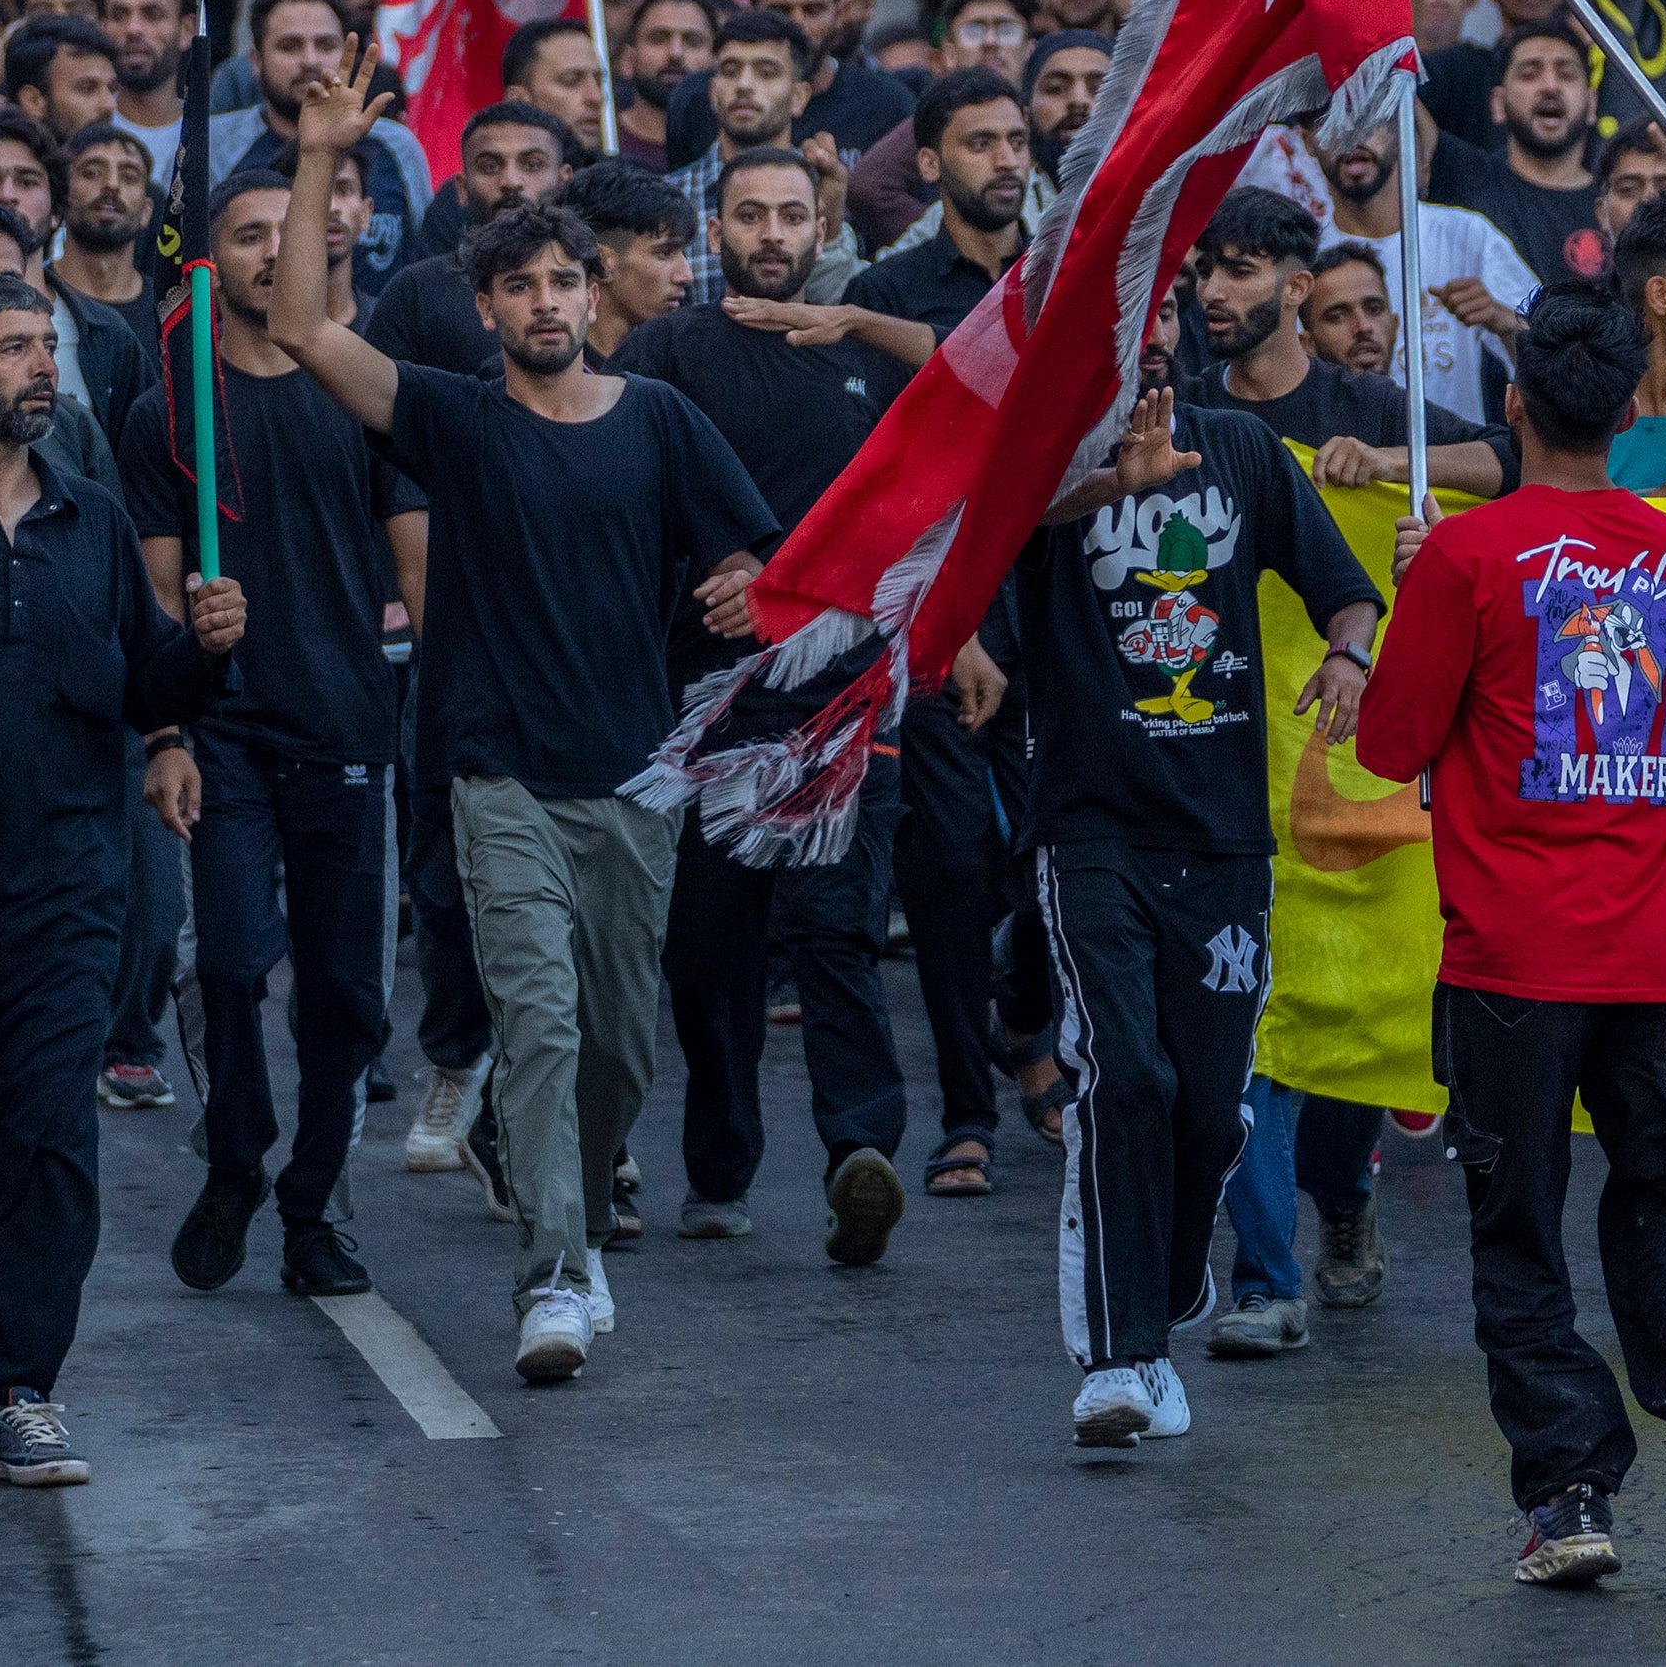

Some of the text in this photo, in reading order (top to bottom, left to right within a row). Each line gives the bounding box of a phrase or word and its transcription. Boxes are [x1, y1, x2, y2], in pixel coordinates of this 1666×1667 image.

[1111, 601, 1143, 618] GO!
[1213, 714, 1228, 725] bad
[1229, 710, 1250, 722] luck
[1149, 729, 1178, 738] MATTER
[1179, 728, 1188, 736] OF
[1201, 924, 1259, 994] NY
